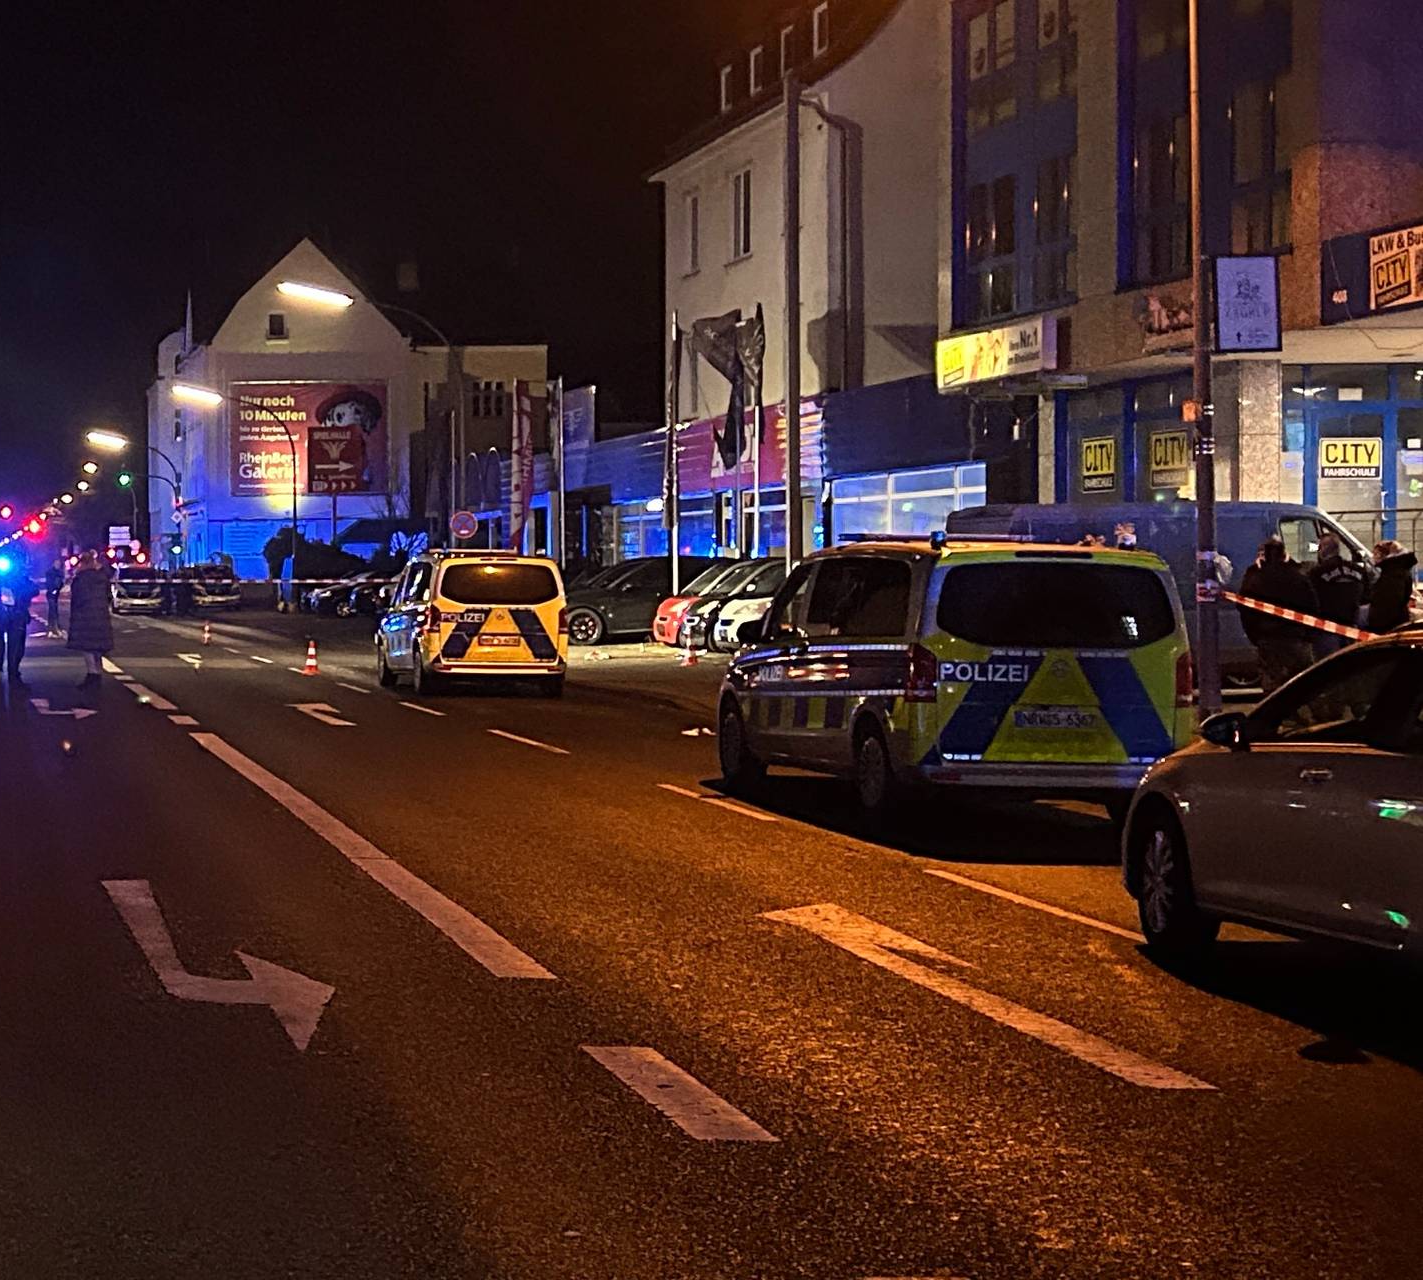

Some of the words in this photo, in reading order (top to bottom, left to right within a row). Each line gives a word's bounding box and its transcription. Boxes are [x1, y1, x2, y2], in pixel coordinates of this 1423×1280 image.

[1372, 235, 1394, 255] LKW
[1397, 233, 1405, 249] &
[1376, 254, 1407, 290] CITY
[263, 395, 295, 407] noch
[239, 410, 254, 421] 10
[254, 410, 307, 421] Minuten
[1085, 443, 1113, 472] CITY
[1154, 436, 1185, 466] CITY
[1325, 443, 1376, 464] CITY
[1324, 467, 1376, 476] FAHRSCHULE
[441, 613, 485, 623] POLIZEI
[940, 663, 1029, 682] POLIZEI
